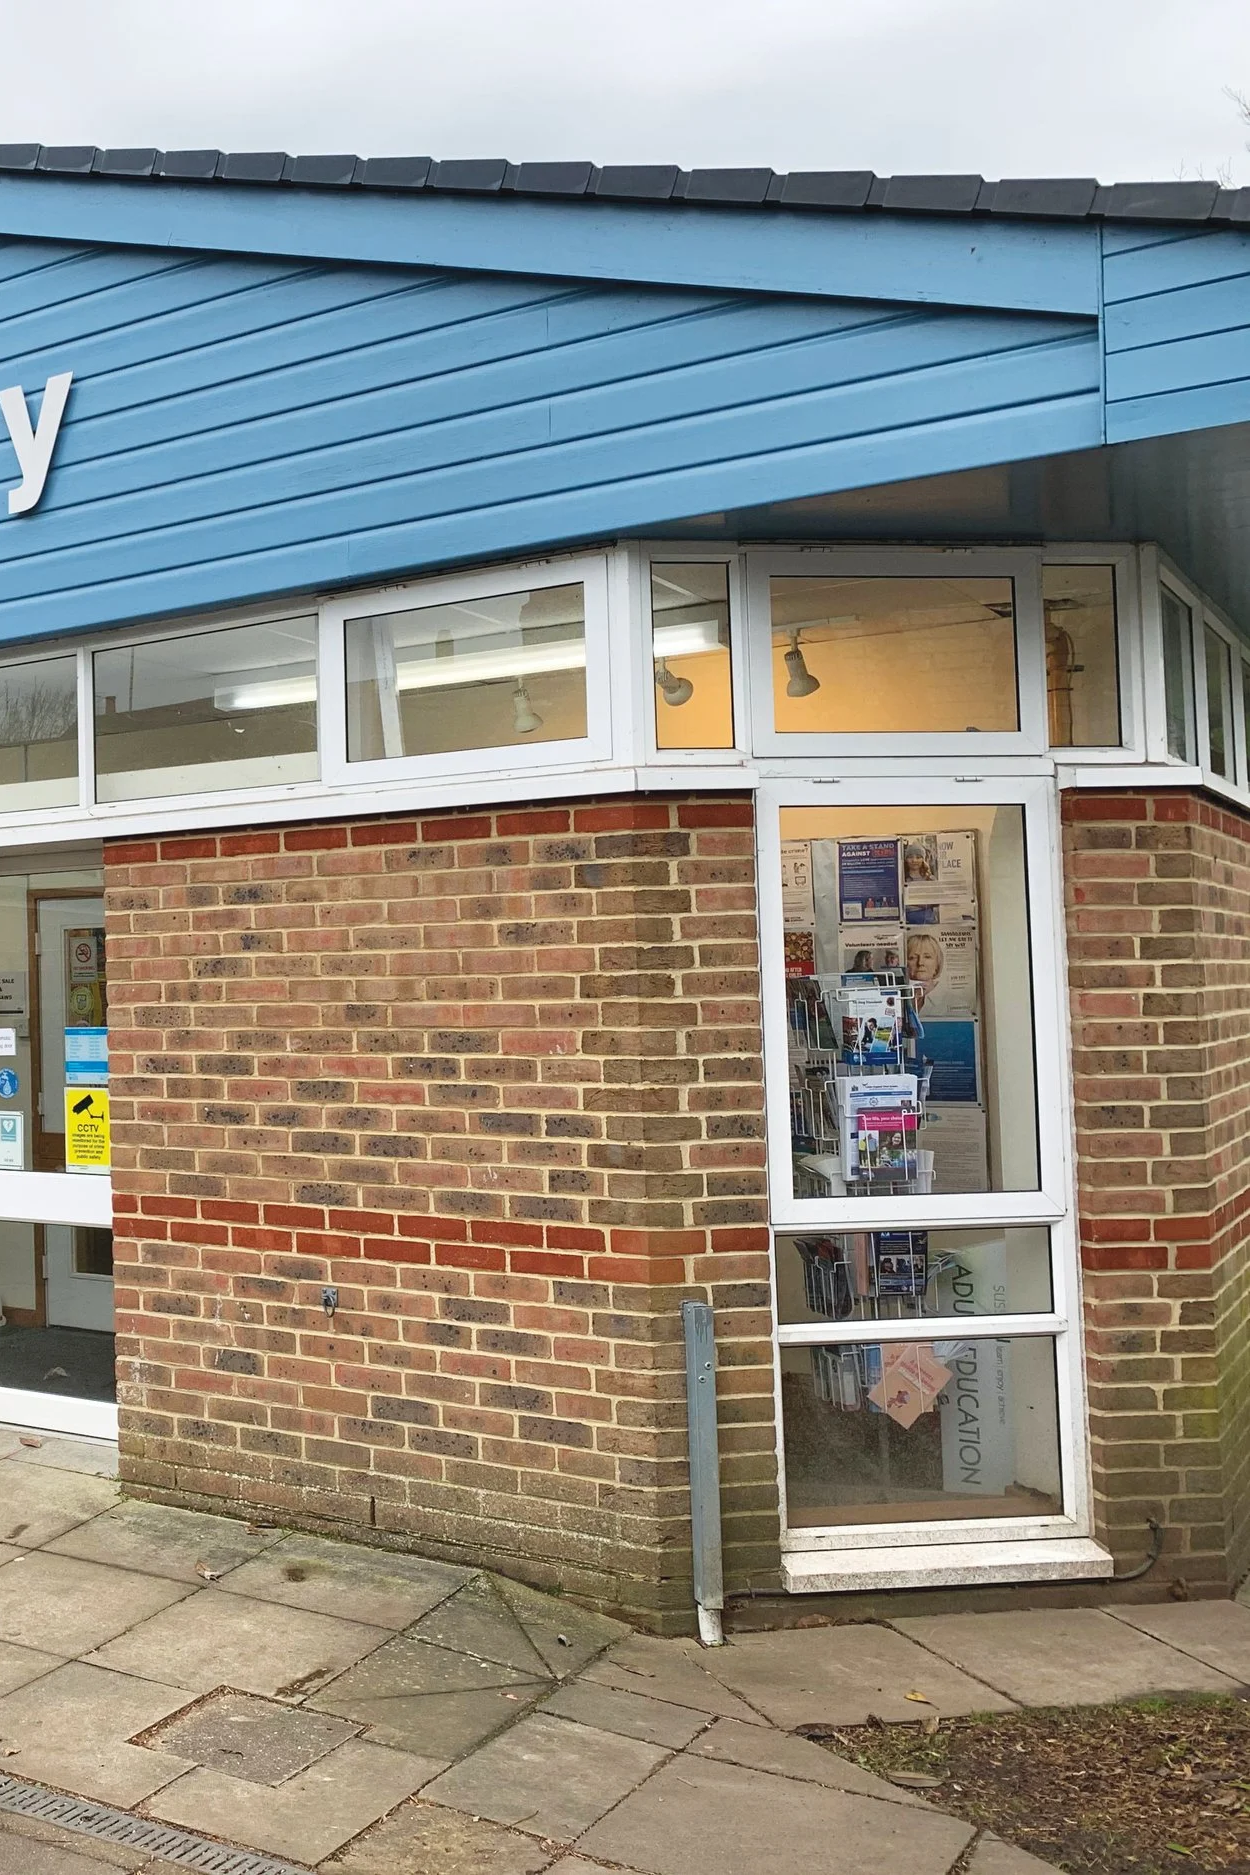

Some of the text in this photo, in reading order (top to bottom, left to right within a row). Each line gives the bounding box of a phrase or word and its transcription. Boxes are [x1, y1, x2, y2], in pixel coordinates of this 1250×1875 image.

[78, 1124, 98, 1132] CCTV
[953, 1264, 974, 1315] ADU
[993, 1285, 1006, 1312] SUS
